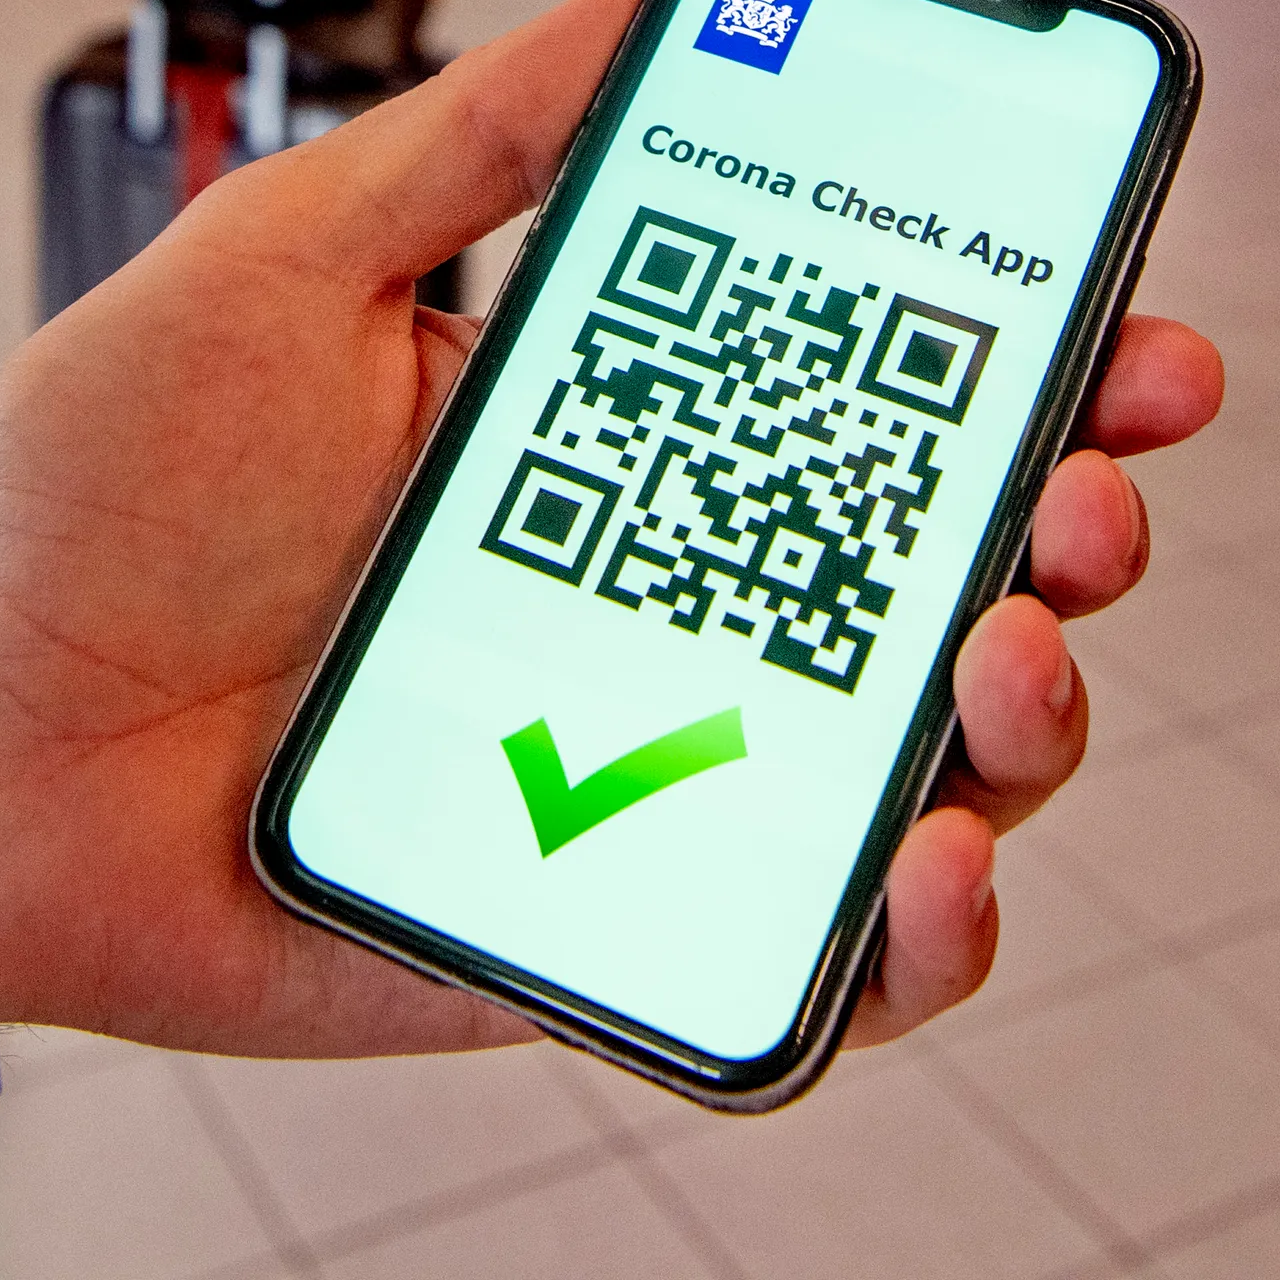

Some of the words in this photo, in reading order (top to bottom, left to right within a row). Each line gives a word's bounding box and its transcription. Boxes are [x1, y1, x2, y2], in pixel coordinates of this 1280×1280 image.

[641, 123, 797, 200] Corona
[810, 179, 952, 251] Check
[957, 229, 1055, 288] App
